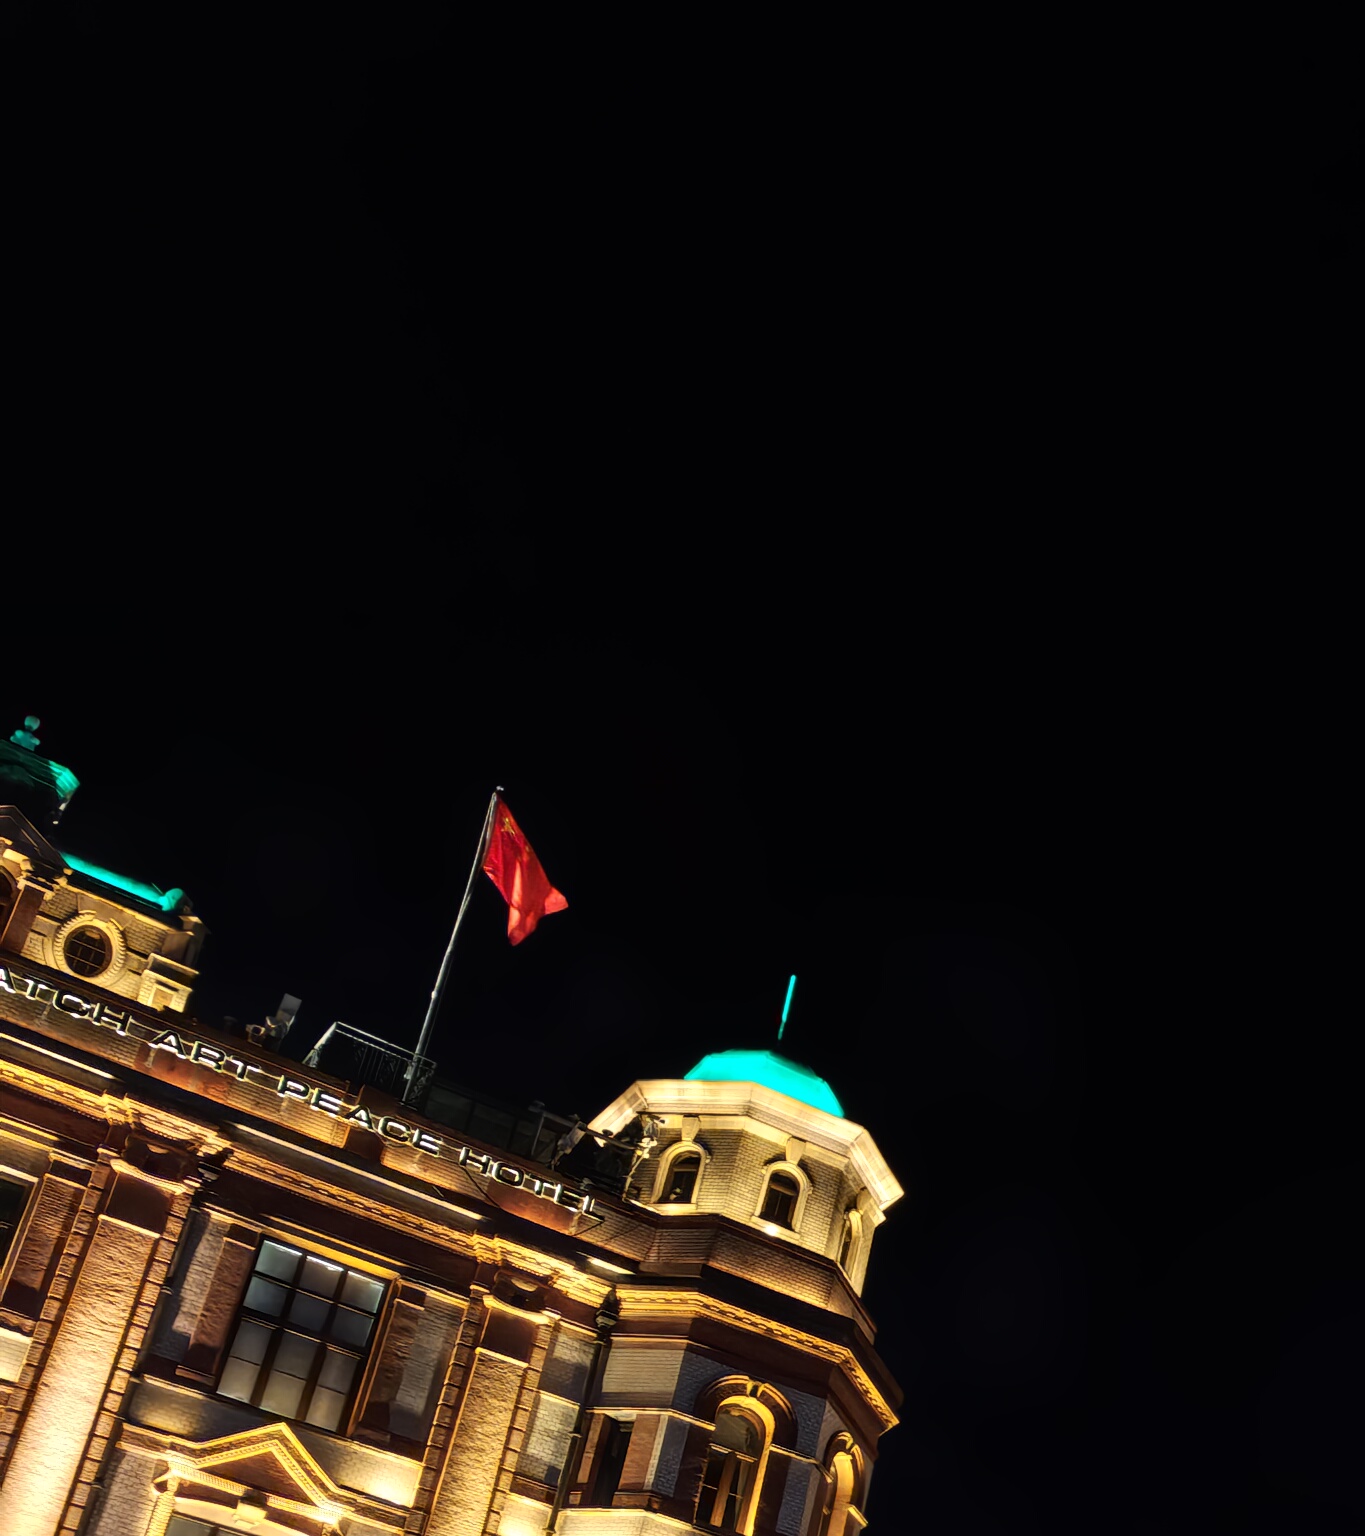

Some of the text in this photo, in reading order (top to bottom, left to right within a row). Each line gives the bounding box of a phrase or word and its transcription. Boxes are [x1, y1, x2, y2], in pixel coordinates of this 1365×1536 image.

[149, 1030, 262, 1081] ART
[277, 1074, 443, 1157] PEACE
[458, 1146, 605, 1222] HOTEL
